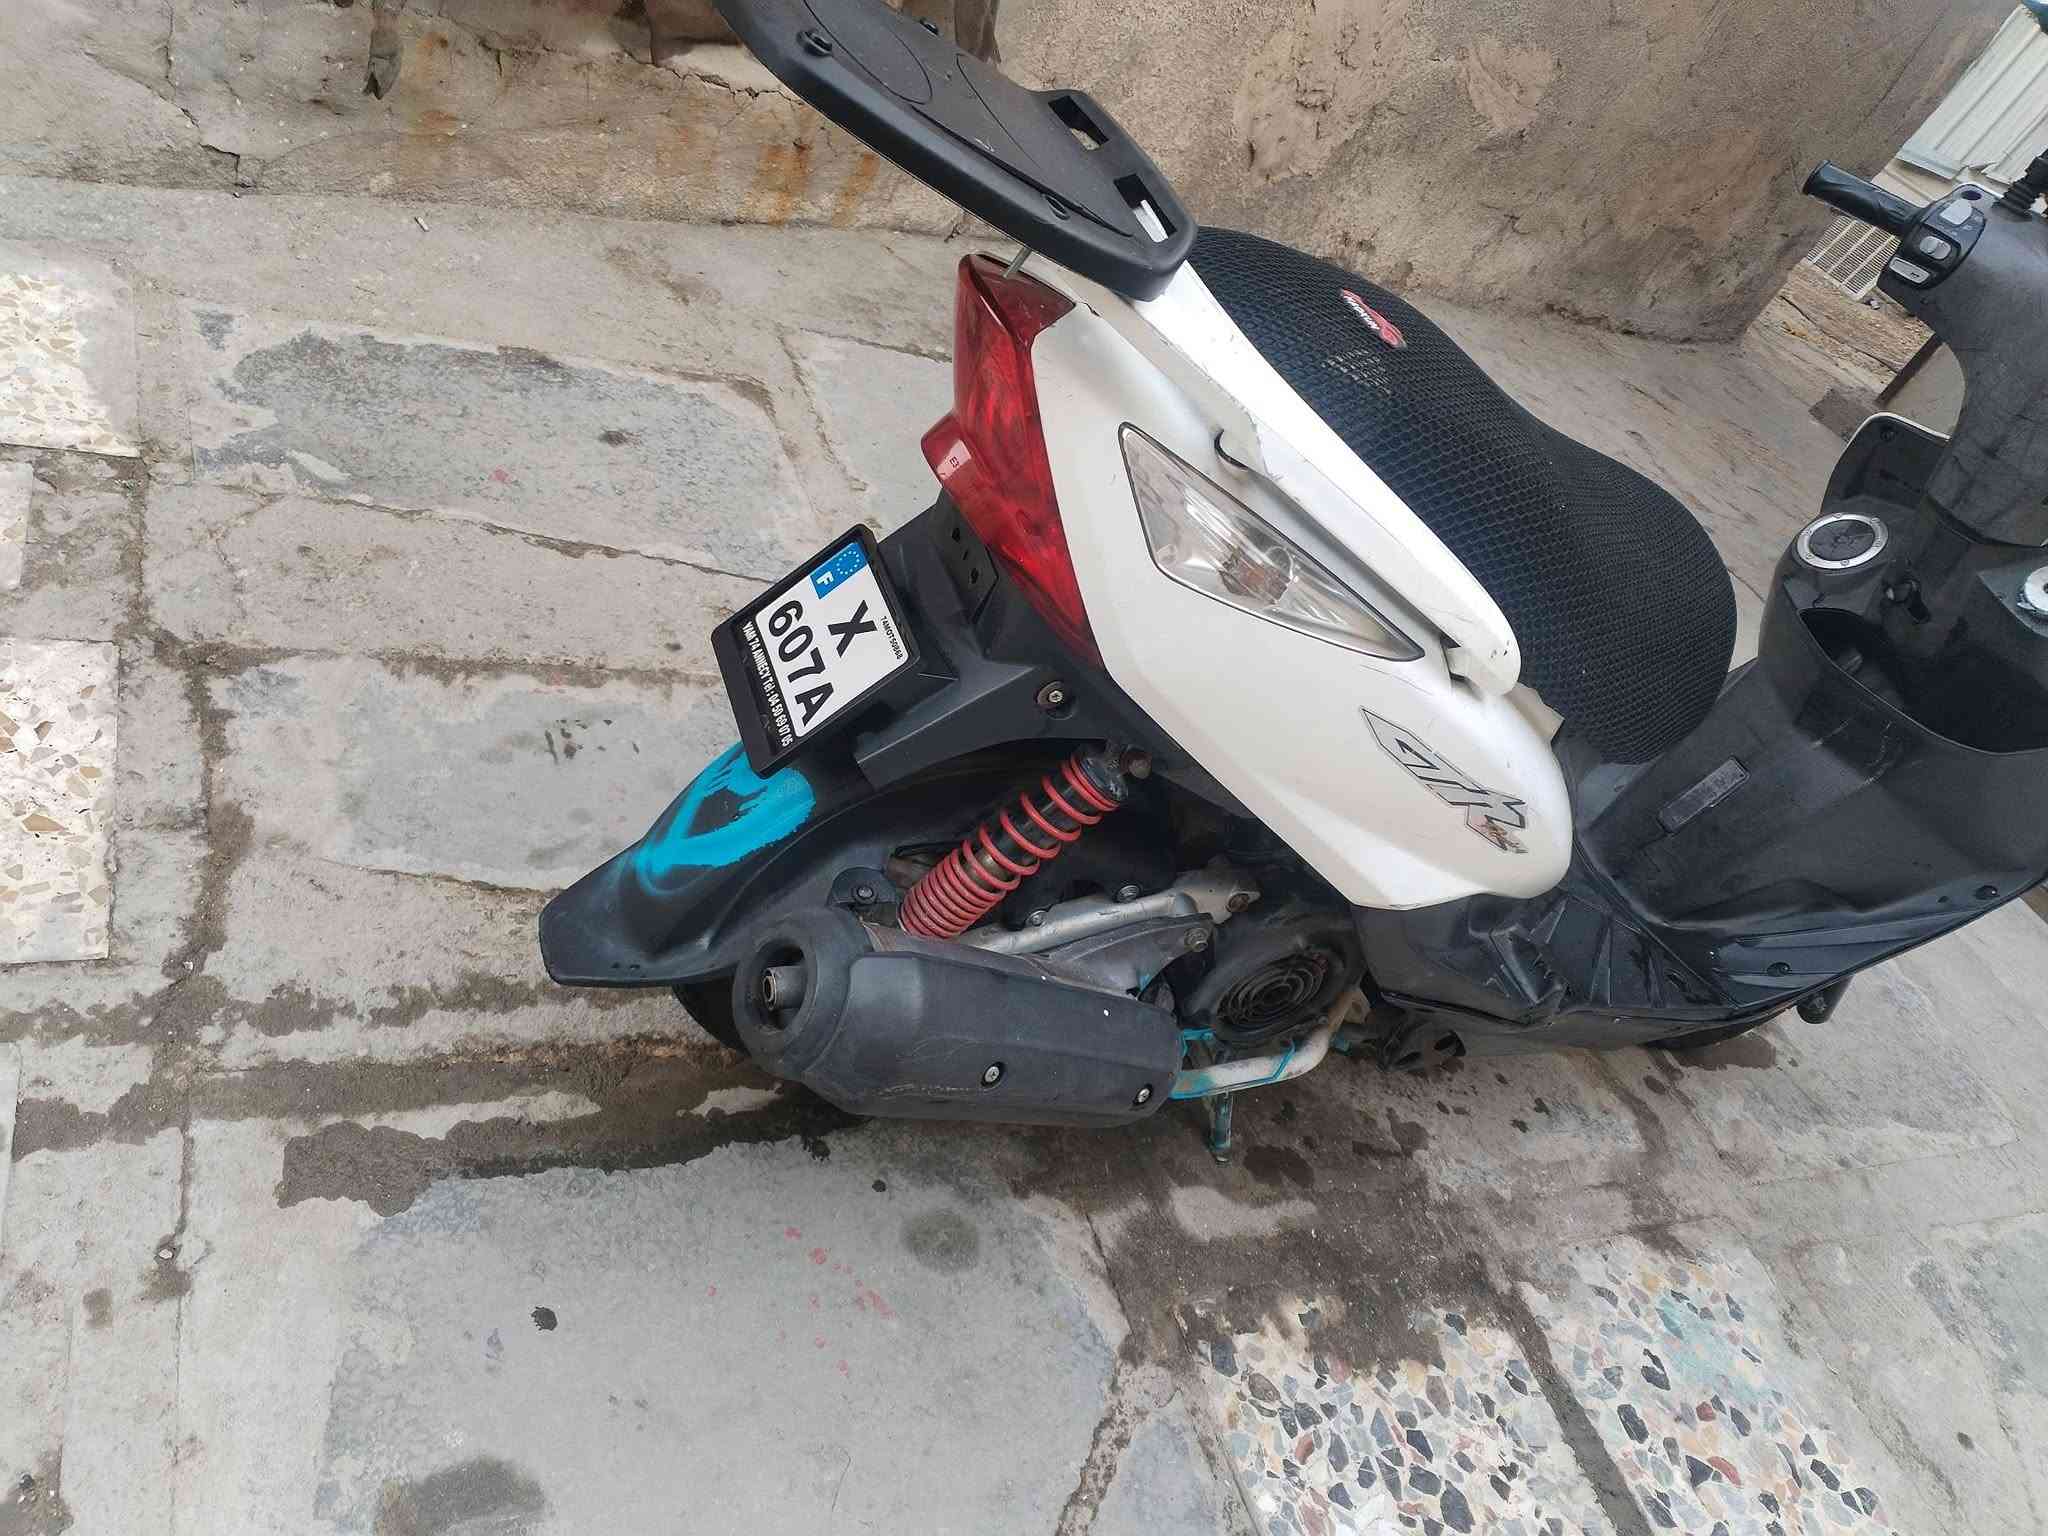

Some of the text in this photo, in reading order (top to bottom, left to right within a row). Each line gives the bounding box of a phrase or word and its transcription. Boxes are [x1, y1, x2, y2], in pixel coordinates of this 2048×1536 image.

[816, 571, 834, 585] F
[742, 621, 757, 642] YAM
[828, 600, 877, 658] X
[749, 637, 761, 651] 74
[768, 600, 834, 727] 607A
[778, 724, 791, 736] 07
